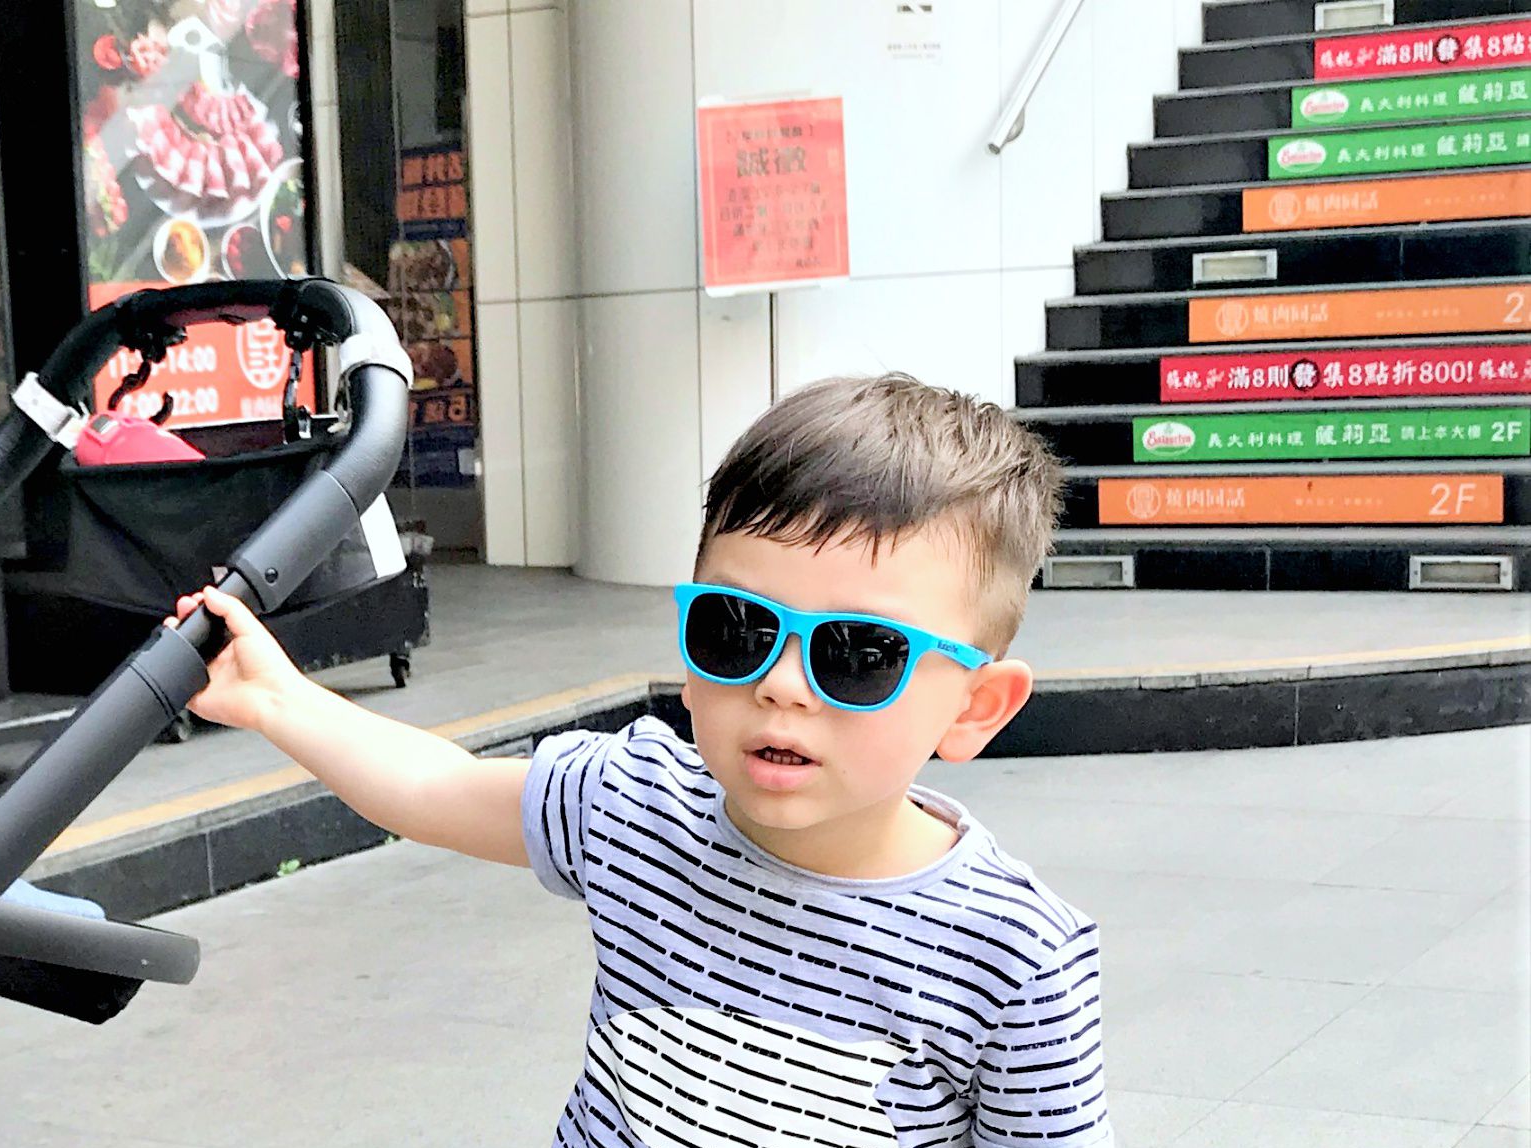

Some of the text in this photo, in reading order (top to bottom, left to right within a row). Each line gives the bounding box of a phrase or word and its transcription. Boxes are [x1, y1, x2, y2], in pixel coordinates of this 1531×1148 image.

[1502, 290, 1531, 324] 2
[1490, 420, 1523, 443] 2F
[1428, 482, 1477, 516] 2F
